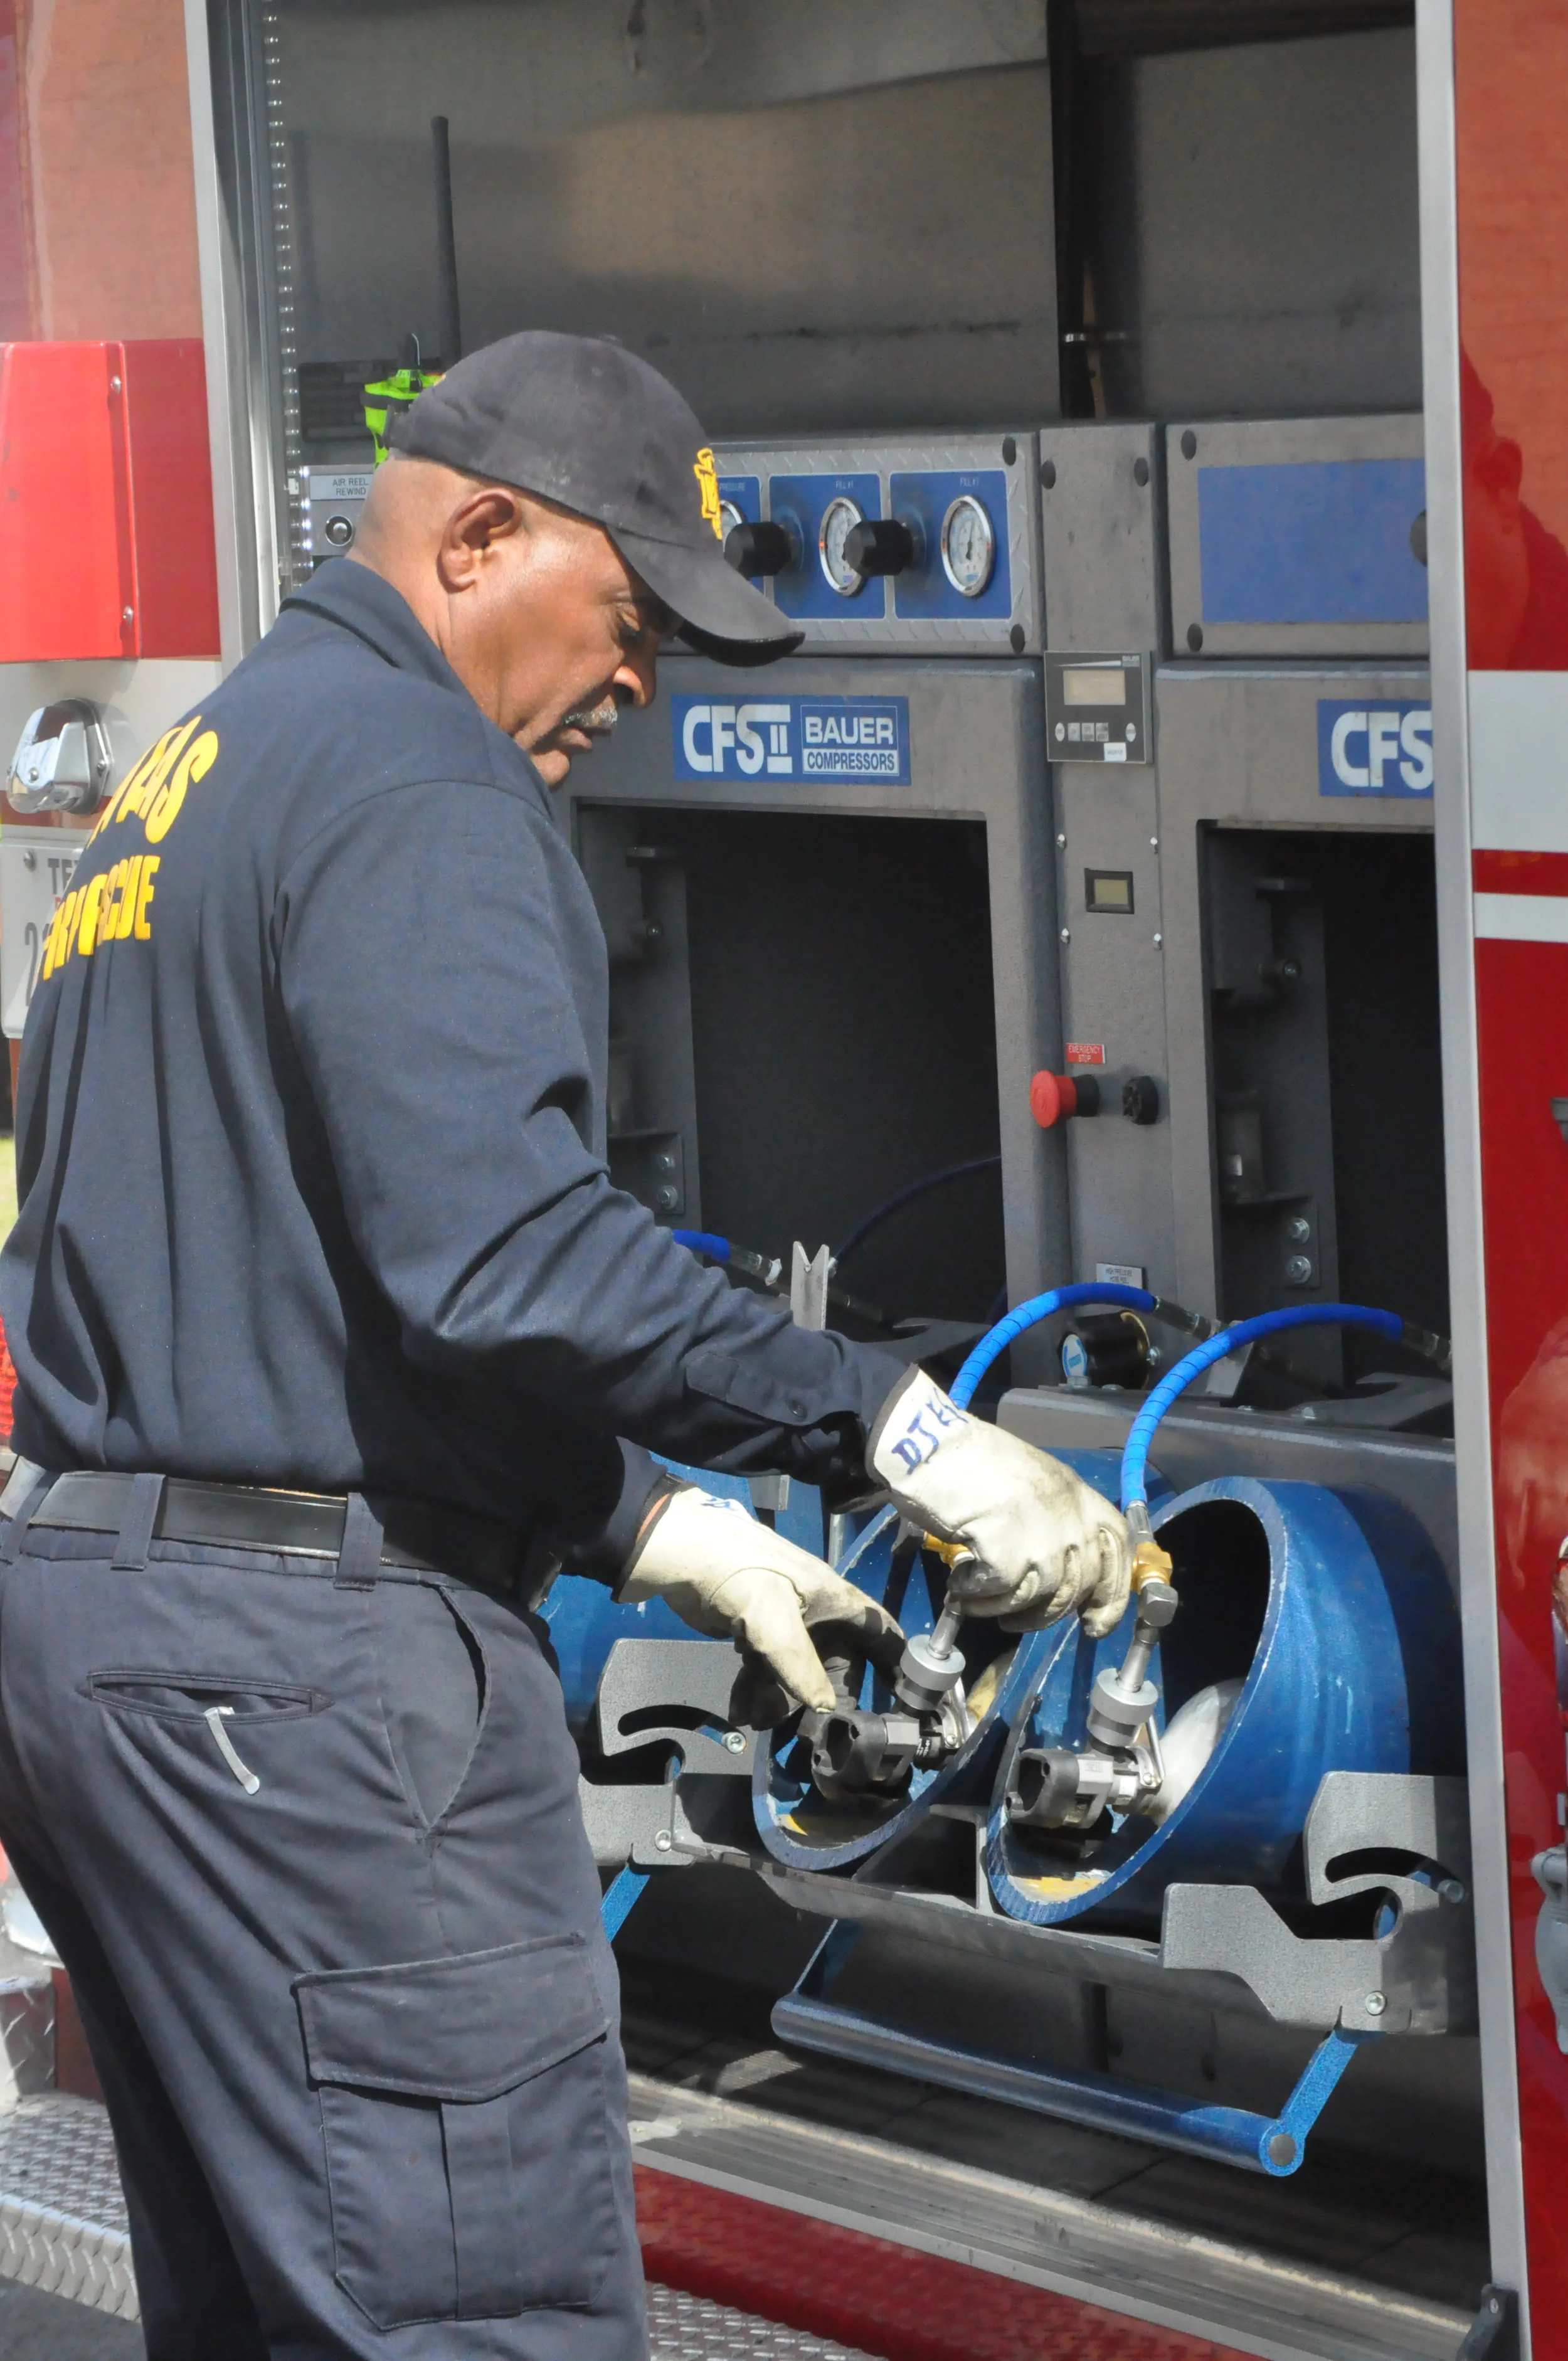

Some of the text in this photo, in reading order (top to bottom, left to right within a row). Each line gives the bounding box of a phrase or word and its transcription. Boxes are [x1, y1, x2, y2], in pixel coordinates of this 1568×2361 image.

[332, 477, 369, 487] AIR REEL
[336, 487, 366, 496] REWIND
[805, 716, 894, 745] BAUER
[807, 751, 895, 772] COMPRESSORS
[1068, 1045, 1101, 1054] EMERGENCY
[1078, 1054, 1091, 1062] STOP
